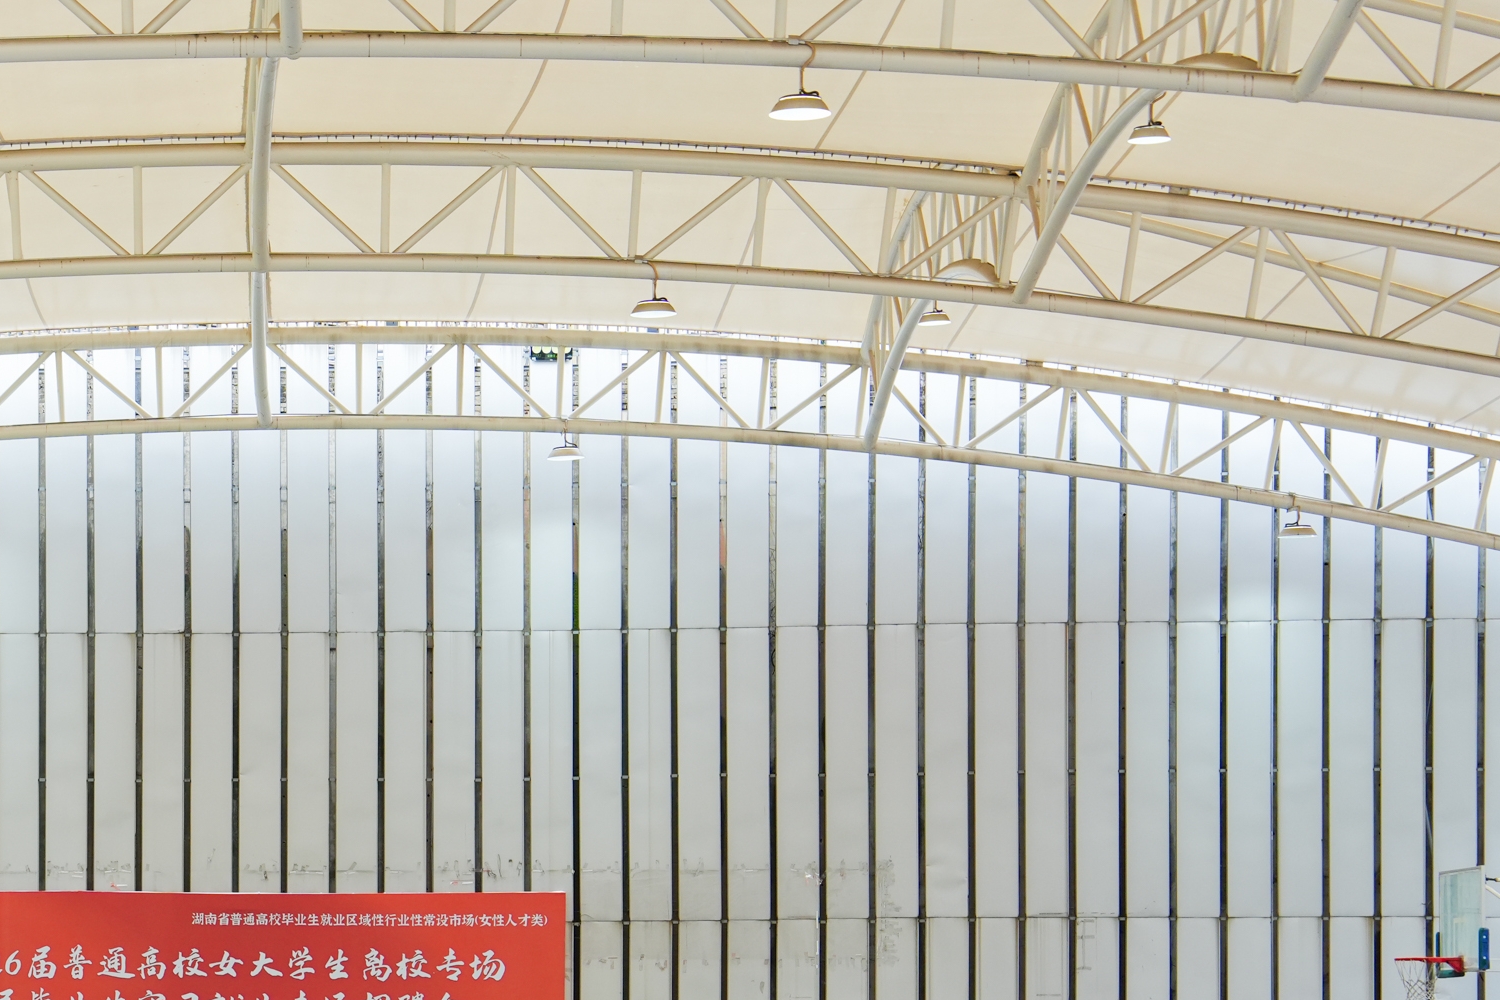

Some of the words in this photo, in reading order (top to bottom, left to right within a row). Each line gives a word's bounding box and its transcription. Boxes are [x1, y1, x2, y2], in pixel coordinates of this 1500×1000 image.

[191, 912, 548, 928] 湖南省普通高校毕业生就业区域性行业性常设市场(女性人才类)
